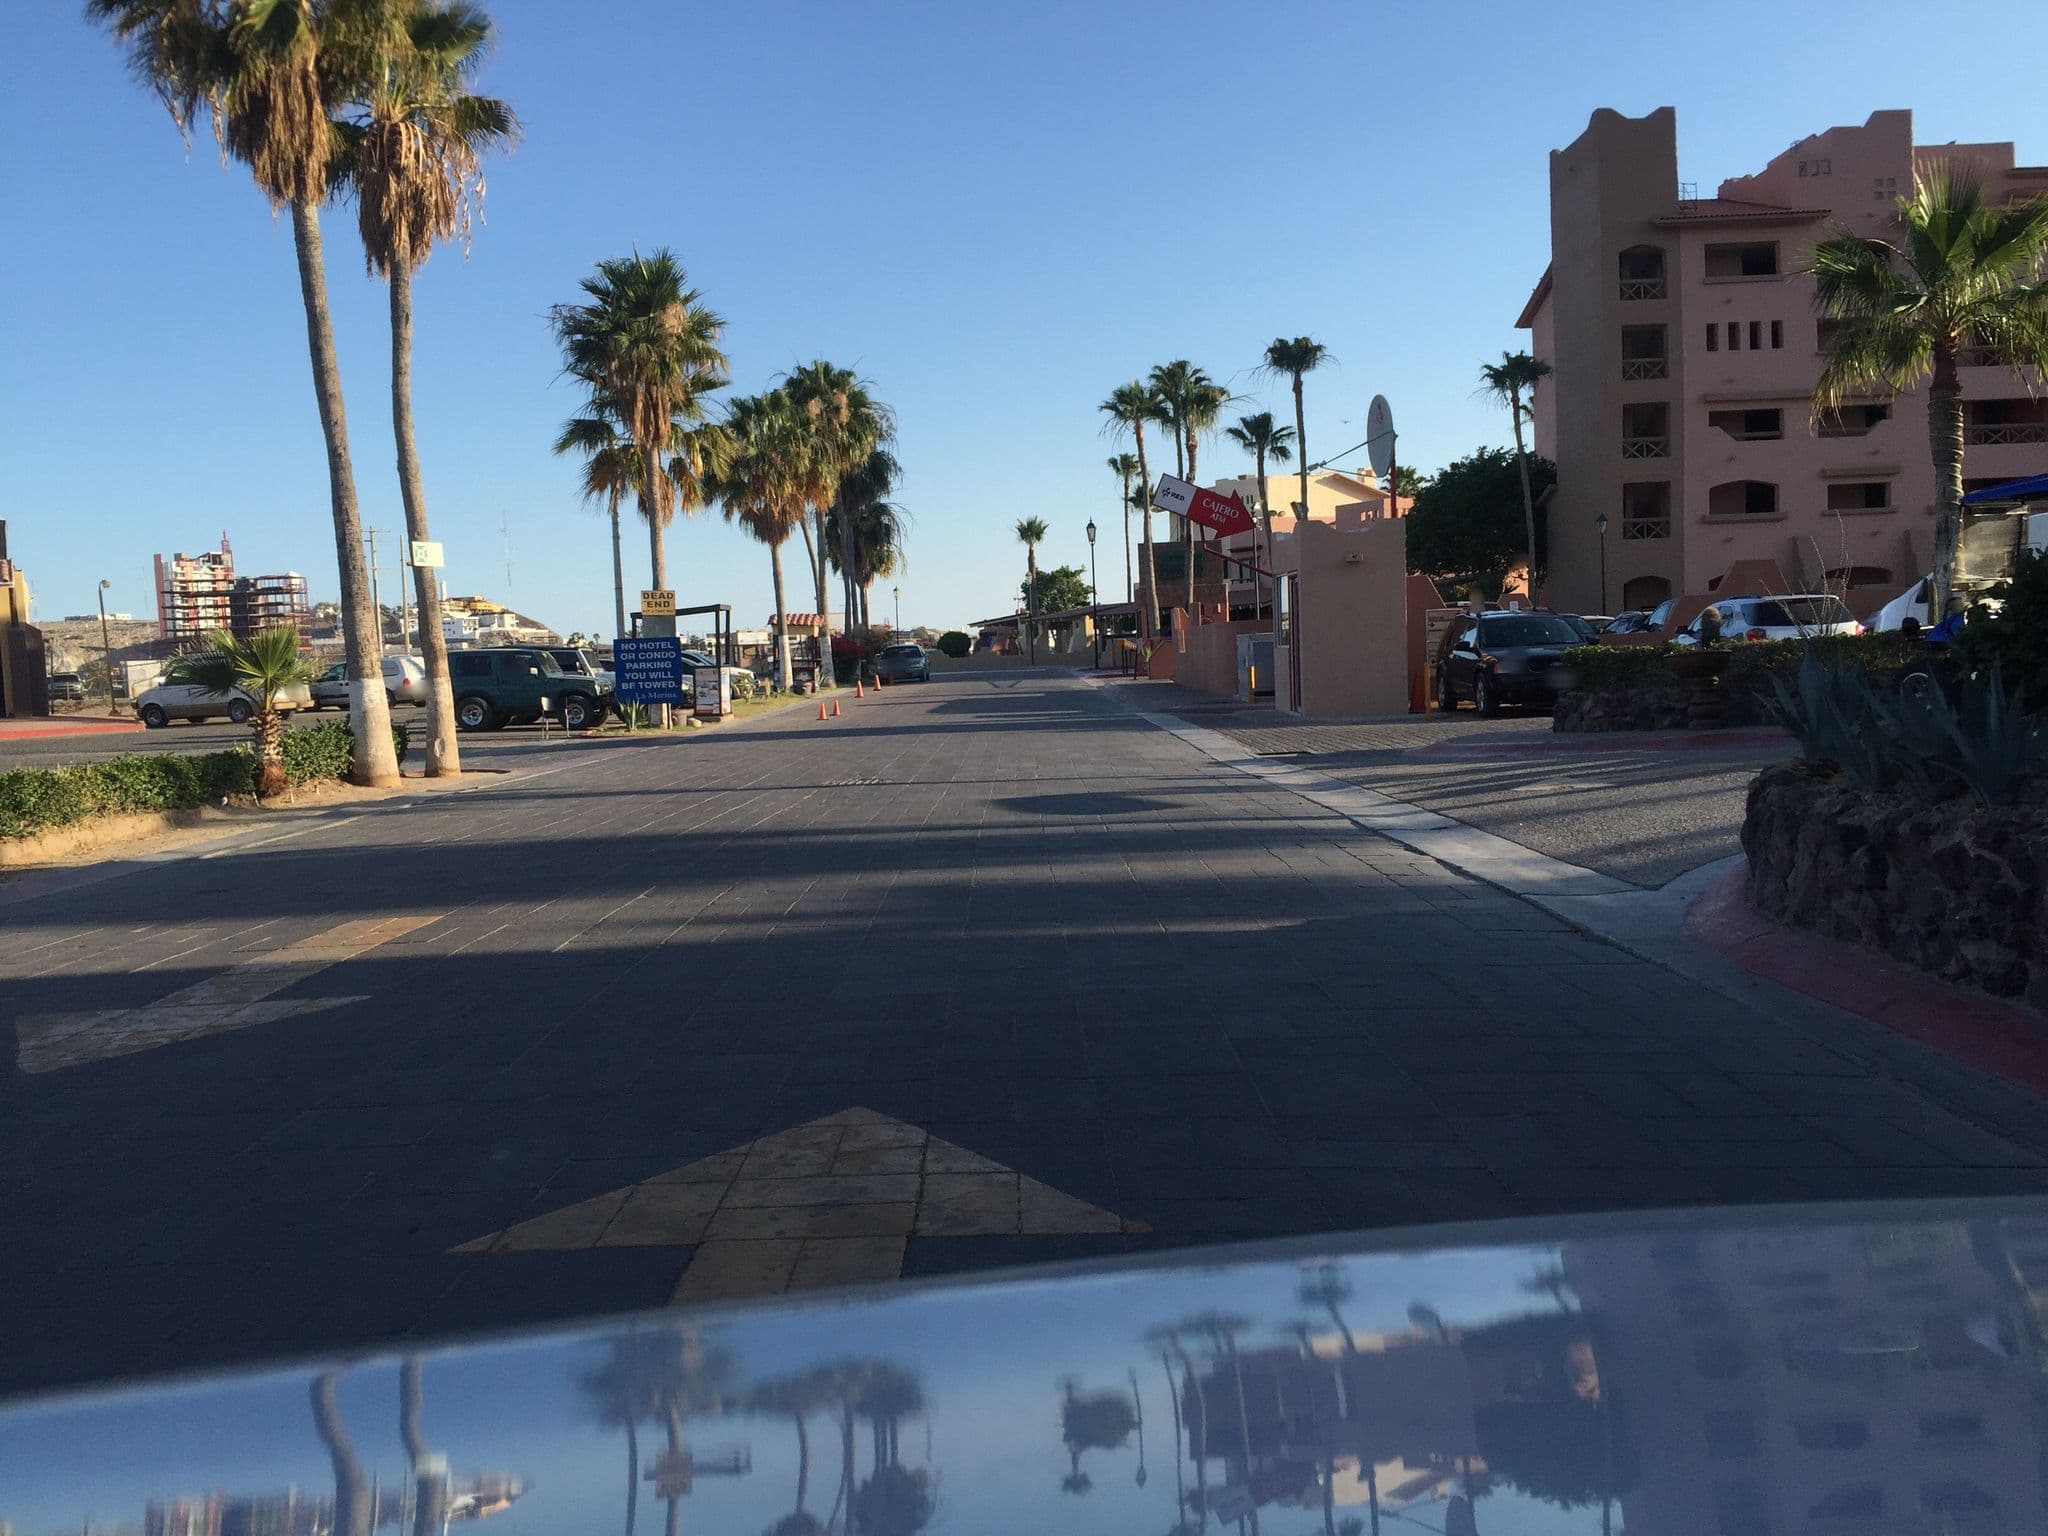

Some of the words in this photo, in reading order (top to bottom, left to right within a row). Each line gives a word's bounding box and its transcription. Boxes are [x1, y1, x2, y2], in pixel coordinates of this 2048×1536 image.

[1202, 498, 1240, 519] CAJERO
[1209, 513, 1227, 524] ATM
[643, 592, 674, 600] DEAD
[646, 600, 671, 608] END
[621, 642, 637, 651] NO
[639, 641, 674, 650] HOTEL
[620, 652, 636, 661] OR
[638, 651, 677, 660] CONDO
[625, 660, 673, 670] PARKING
[624, 672, 647, 680] YOU
[648, 671, 675, 679] WILL
[621, 681, 636, 690] BE
[638, 680, 679, 689] TOWED.
